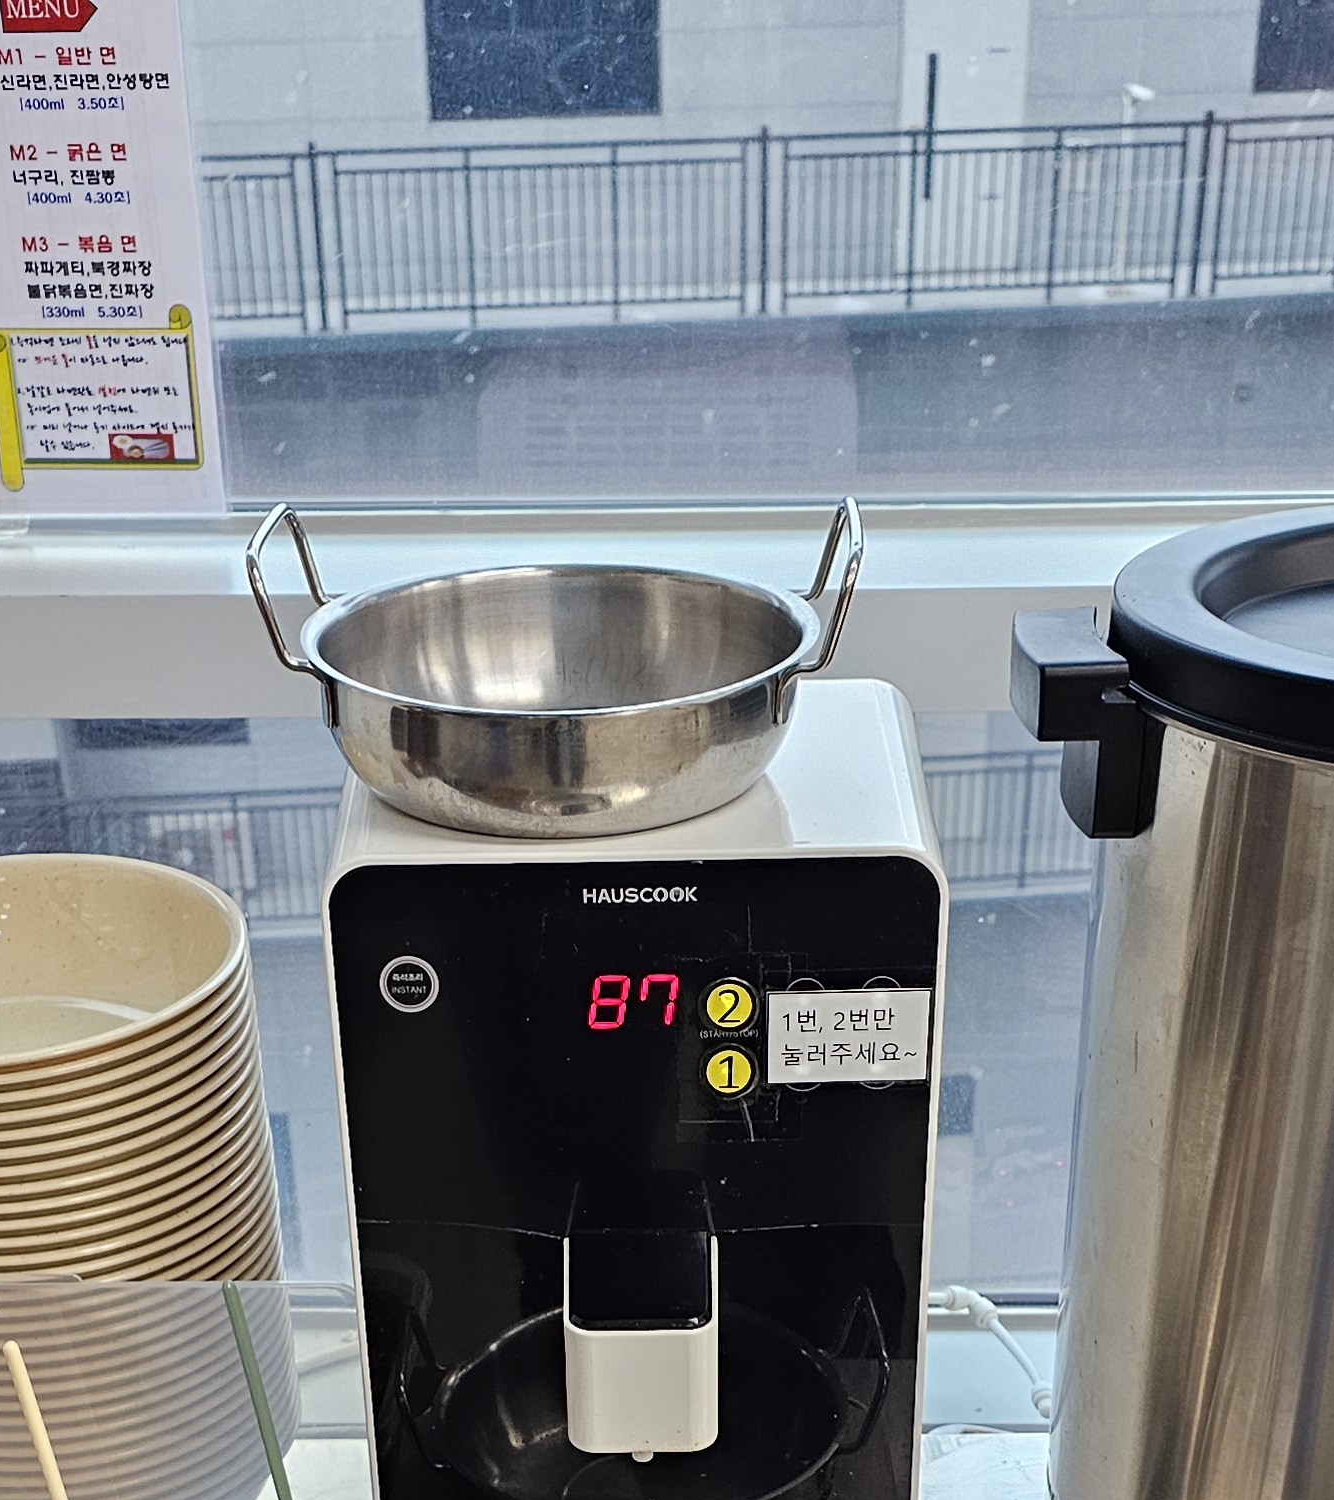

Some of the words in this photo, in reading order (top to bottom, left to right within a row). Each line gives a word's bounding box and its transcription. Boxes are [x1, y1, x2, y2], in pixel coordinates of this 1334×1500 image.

[7, 0, 79, 18] MENU
[56, 47, 92, 66] 일반
[100, 47, 116, 65] 면
[10, 144, 37, 161] M2
[67, 143, 102, 161] 굵은
[110, 143, 127, 161] 면
[13, 170, 64, 186] 너구리,
[70, 170, 115, 185] 진짬뽕
[22, 237, 49, 252] M3
[78, 235, 112, 253] 볶음
[121, 235, 137, 253] 면
[582, 886, 698, 904] HAUSCOOK
[391, 985, 427, 994] INSTANT
[588, 973, 680, 1030] 87
[718, 989, 741, 1023] 2
[782, 1009, 823, 1034] 1번,
[833, 1008, 895, 1032] 2번만
[780, 1041, 917, 1067] 눌러주세요~
[718, 1055, 740, 1089] 1
